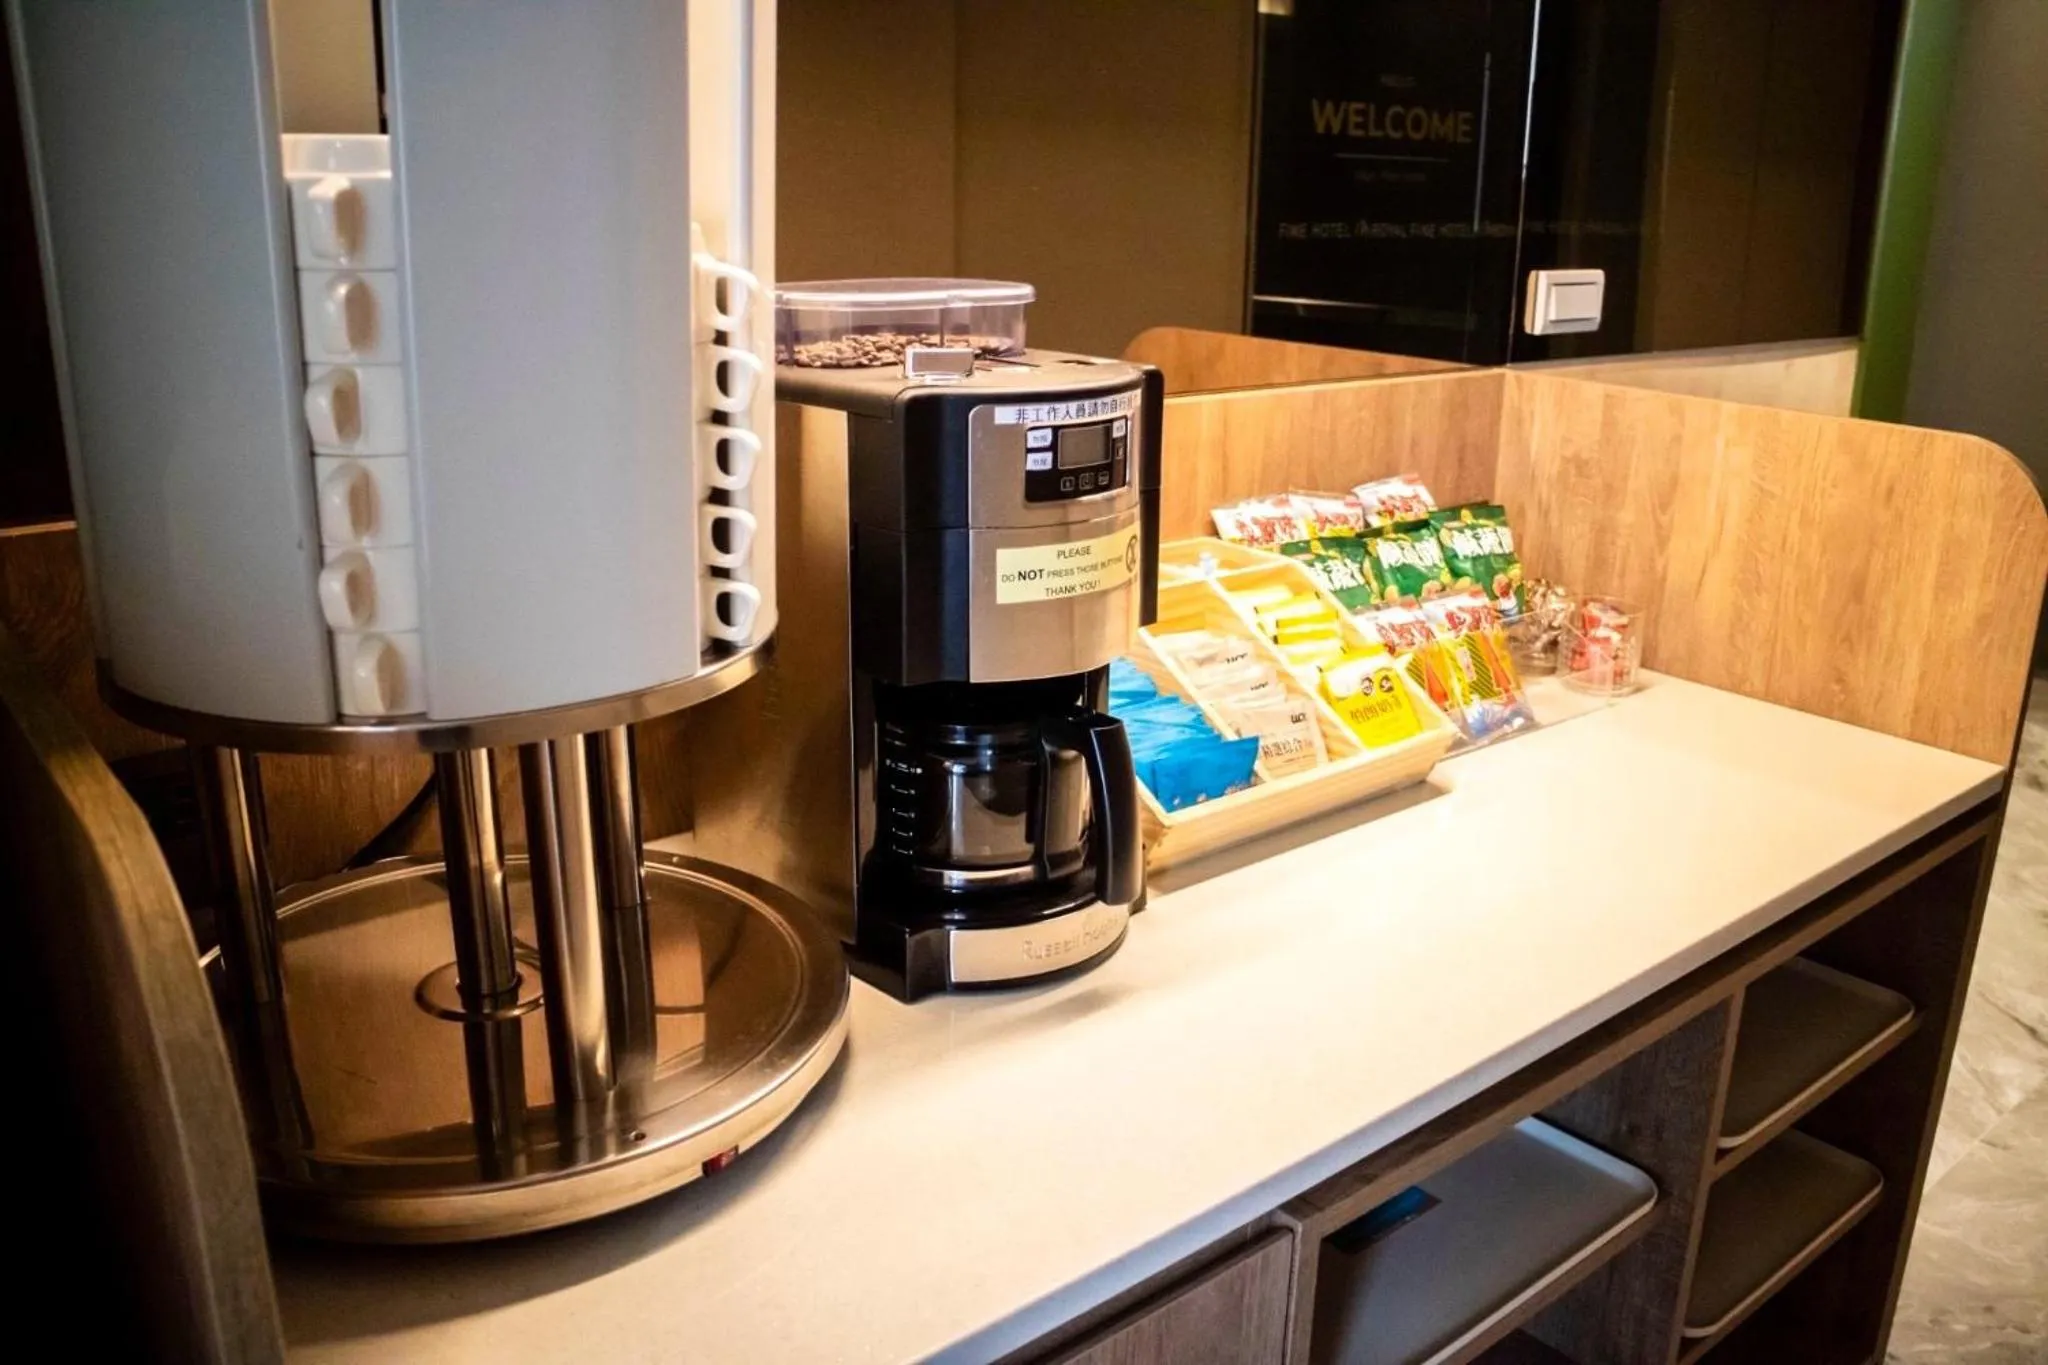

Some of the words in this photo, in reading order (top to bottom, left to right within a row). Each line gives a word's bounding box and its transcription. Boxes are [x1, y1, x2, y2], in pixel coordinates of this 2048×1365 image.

[1311, 98, 1475, 143] WELCOME
[1056, 545, 1092, 559] PLEASE
[1001, 574, 1016, 583] DO
[1017, 569, 1045, 581] NOT
[1047, 567, 1075, 579] PRESS
[1045, 583, 1077, 597] THANK
